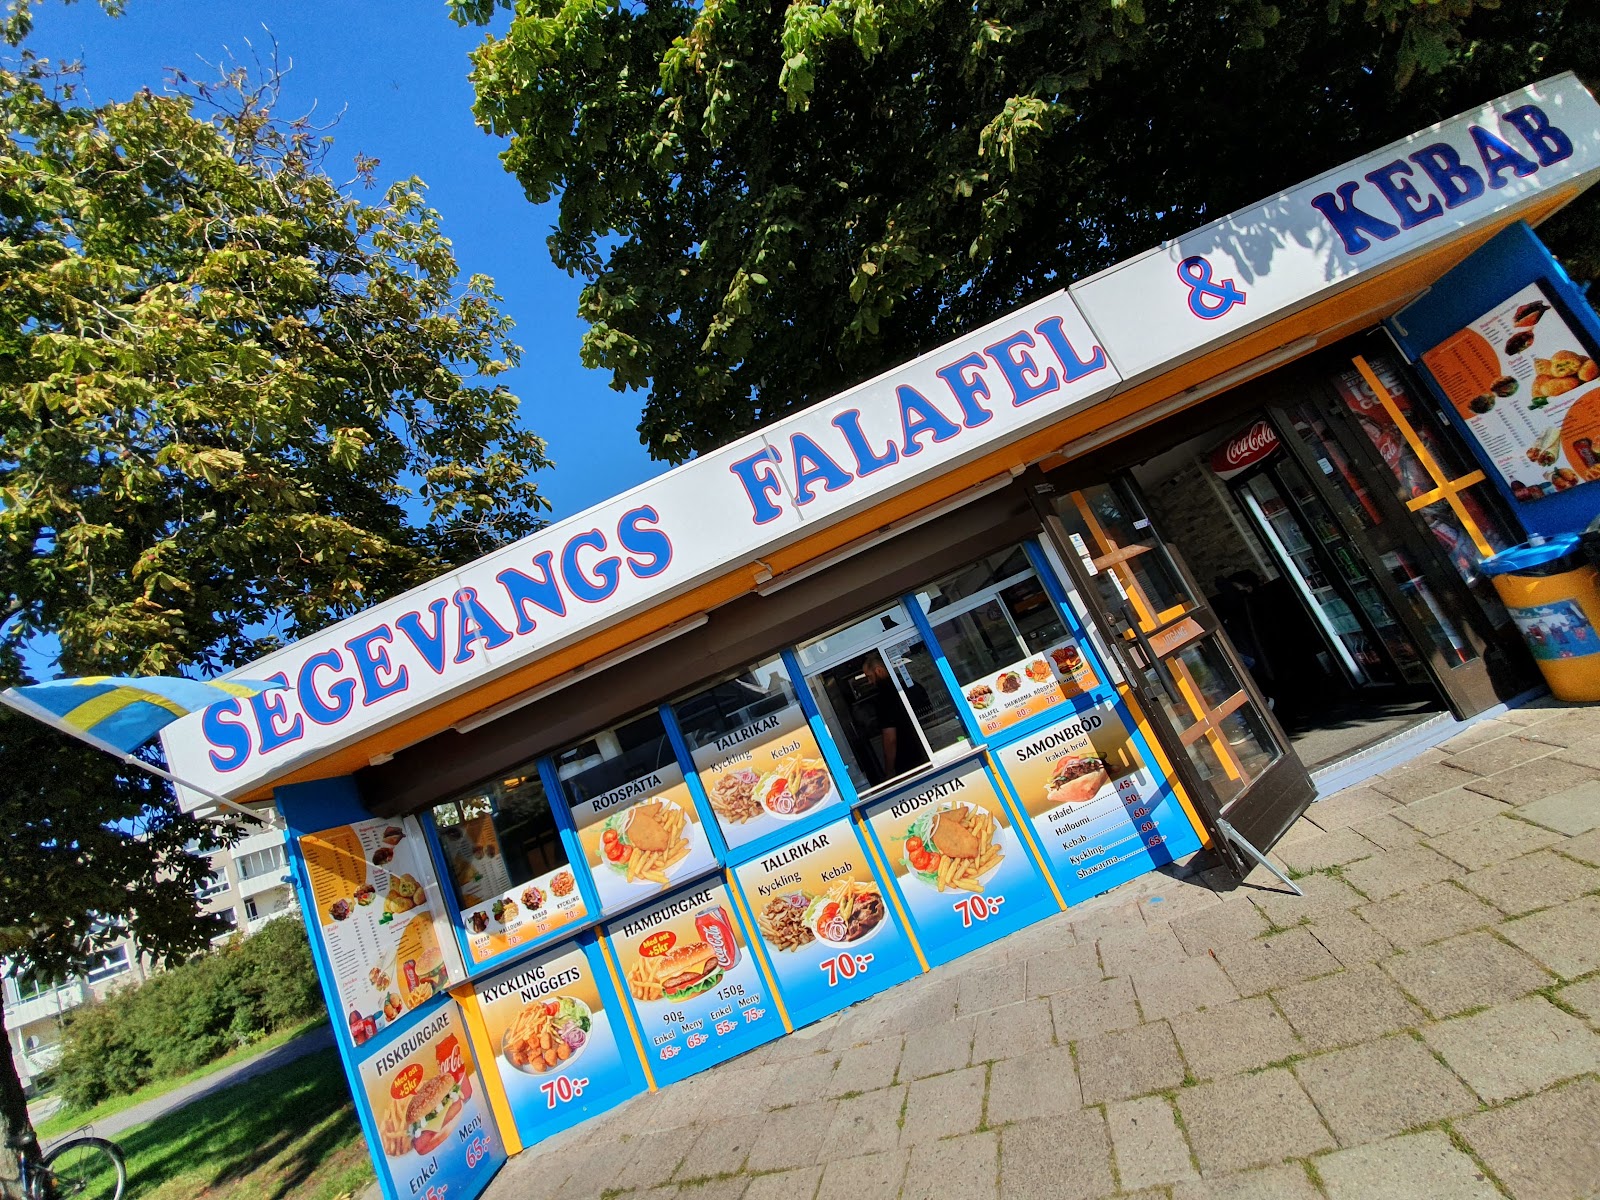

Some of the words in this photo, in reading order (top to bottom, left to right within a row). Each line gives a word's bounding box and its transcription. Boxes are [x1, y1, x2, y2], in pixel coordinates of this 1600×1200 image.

[202, 504, 674, 773] SEGEVÅNGS
[729, 316, 1106, 527] FALAFEL
[1177, 256, 1246, 320] &
[1311, 104, 1574, 256] KEBAB
[1226, 420, 1277, 465] Coca-Cola
[979, 707, 999, 720] FALAFEL
[1004, 693, 1032, 709] SHAWARMA
[713, 715, 780, 752] TALLRIKAR
[1016, 714, 1102, 762] SAMONBRÖD
[710, 751, 752, 773] Kyckling
[770, 740, 801, 759] Kebab
[1045, 747, 1069, 763] Irakisk
[1070, 738, 1088, 754] bröd
[592, 774, 662, 813] RÖDSPÄTTA
[890, 777, 965, 819] RÖDSPÄTTA
[1048, 805, 1074, 823] Falafel
[1055, 816, 1091, 836] Halloumi
[760, 834, 830, 873] TALLRIKAR
[1062, 833, 1087, 851] Kebab
[1069, 843, 1104, 866] Kyckling
[757, 871, 802, 896] Kyckling
[821, 862, 853, 883] Kebab
[1076, 855, 1119, 880] Shawarma
[623, 888, 713, 937] HAMBURGARE
[954, 894, 1005, 928] 70:-
[482, 966, 546, 1003] KYCKLING
[521, 966, 580, 1003] NUGGETS
[820, 952, 874, 986] 70:-
[710, 1004, 732, 1021] Enkel
[738, 993, 760, 1009] Meny
[717, 983, 745, 1002] 150g
[654, 1030, 676, 1046] Enkel
[681, 1018, 704, 1034] Meny
[663, 1009, 685, 1025] 90g
[375, 1012, 450, 1077] FISKBURGARE
[394, 1072, 407, 1088] Med
[399, 1077, 417, 1098] +5kr
[540, 1076, 589, 1108] 70:-
[458, 1113, 483, 1142] Meny
[465, 1136, 491, 1169] 65:-
[409, 1156, 438, 1195] Enkel
